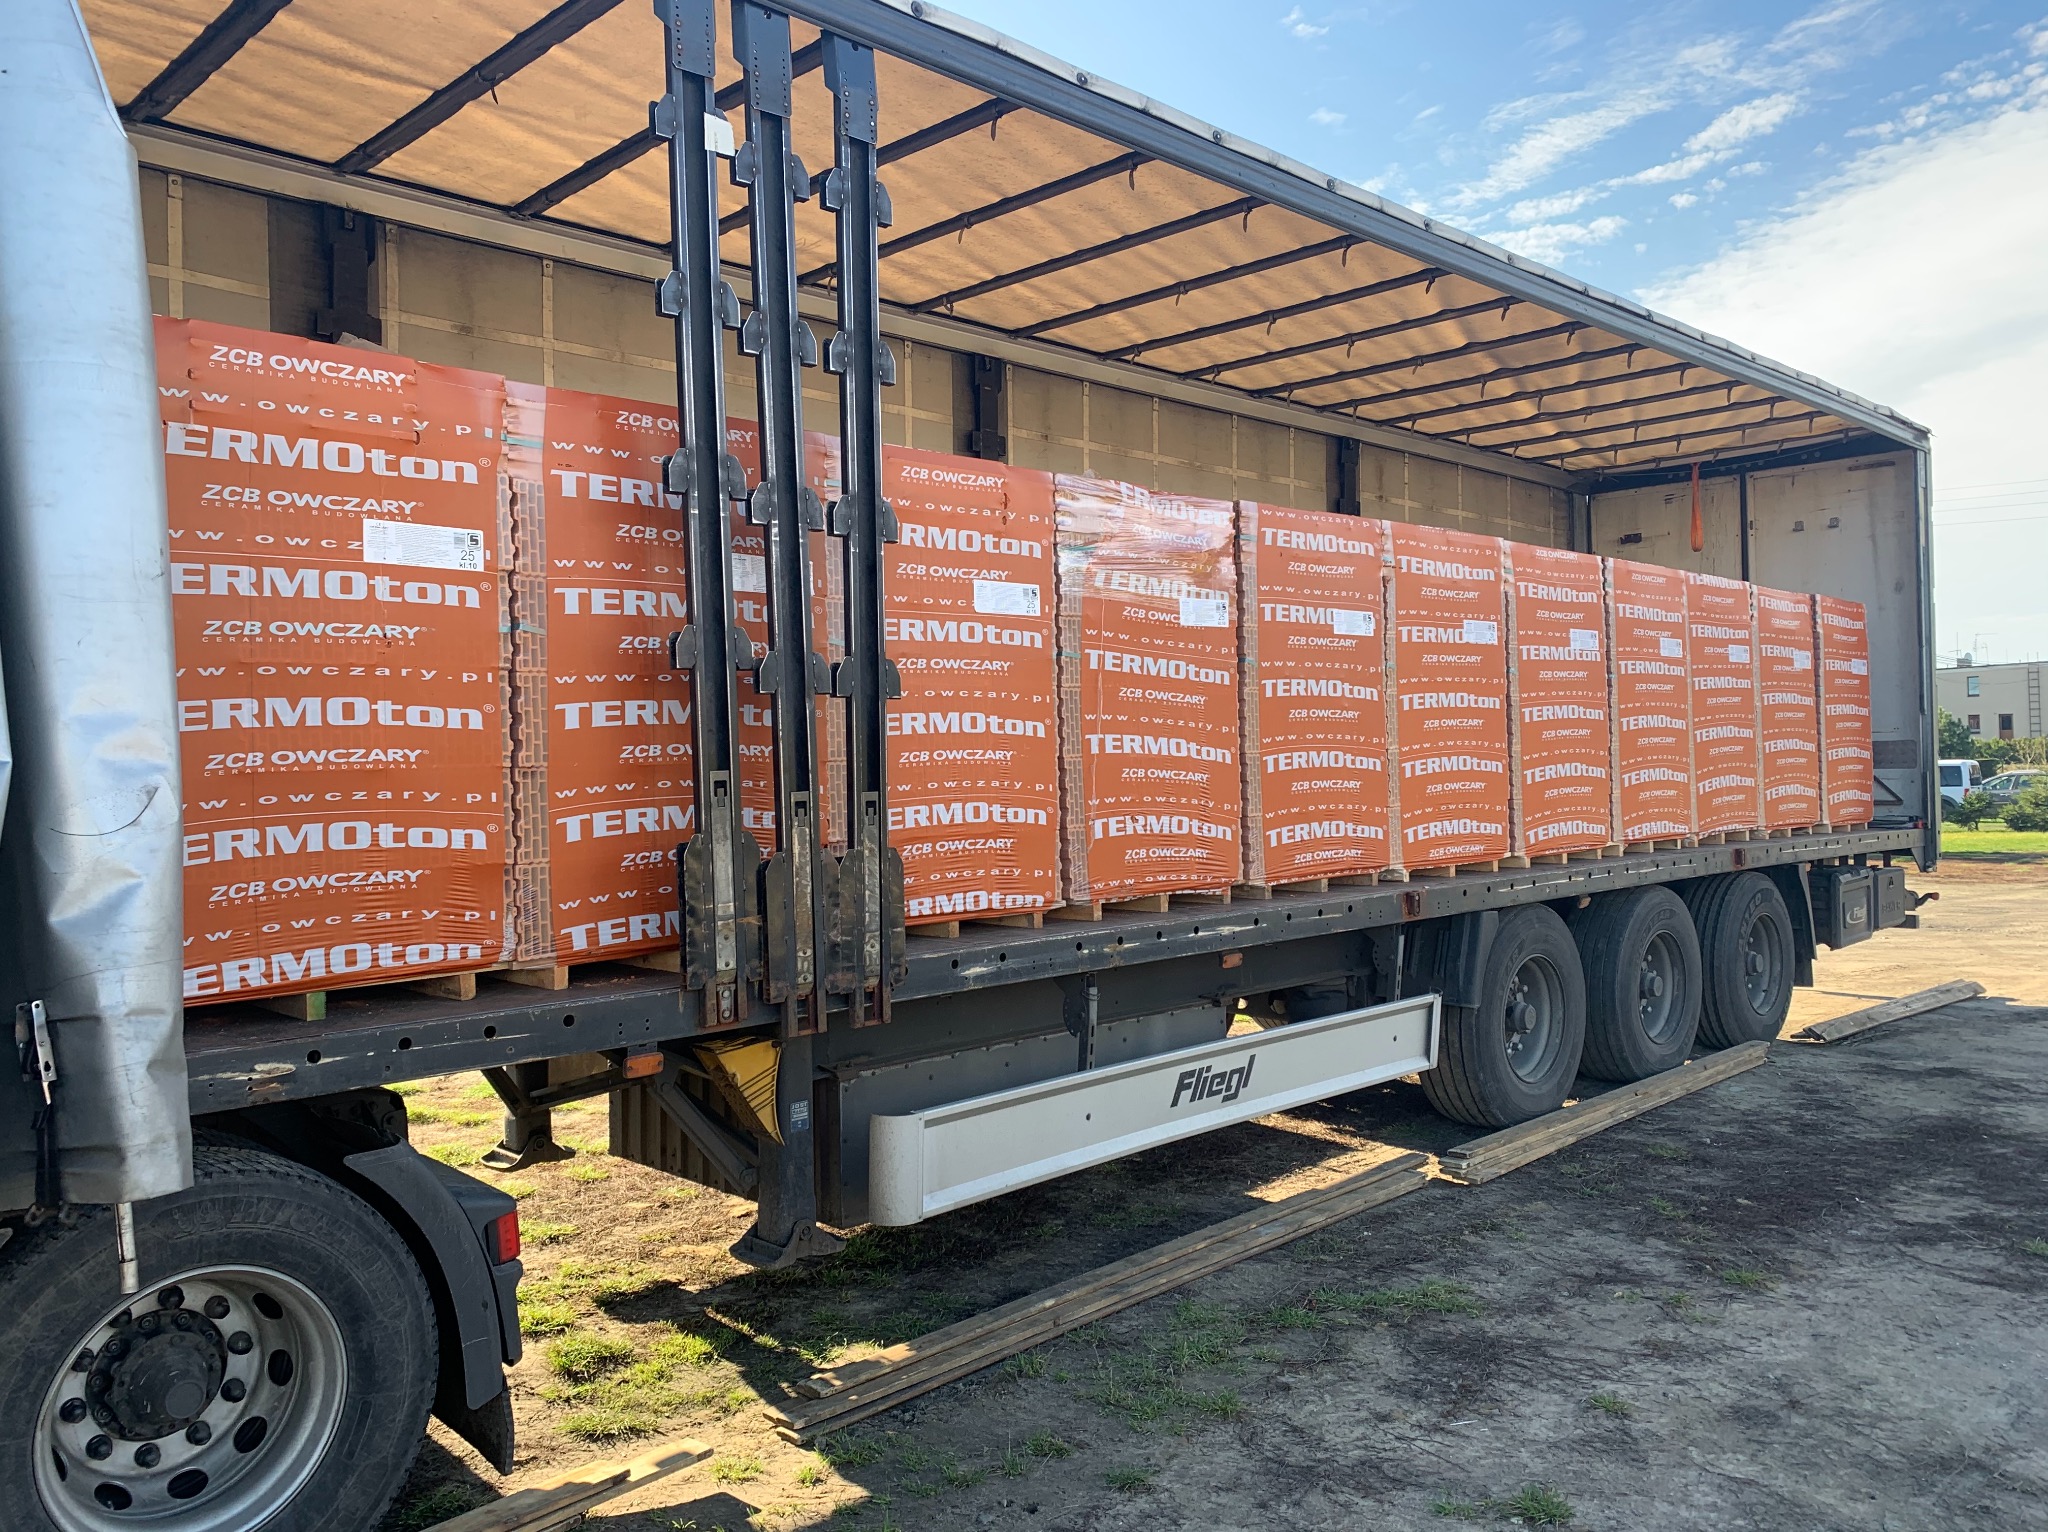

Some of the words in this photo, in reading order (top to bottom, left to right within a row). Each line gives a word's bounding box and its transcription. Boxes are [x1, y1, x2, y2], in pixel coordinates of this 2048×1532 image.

[209, 345, 262, 367] ZCB
[270, 355, 406, 387] OWCZARY
[209, 362, 295, 379] CERAMIKA
[311, 376, 403, 394] BUDOWLANA
[616, 411, 654, 427] ZCB
[616, 425, 676, 438] CERAMIKA
[166, 422, 479, 484] ERMOton
[902, 466, 928, 479] ZCB
[932, 470, 1004, 488] OWCZARY
[202, 484, 260, 502] ZCB
[268, 491, 418, 514] OWCZARY
[201, 500, 295, 514] CERAMIKA
[312, 509, 413, 522] BUDOWLANA
[616, 524, 658, 540] ZCB
[901, 523, 1041, 559] RMOton
[616, 537, 683, 548] CERAMIKA
[1261, 528, 1374, 557] TERMOton
[461, 550, 474, 561] 25
[897, 563, 926, 575] ZCB
[930, 566, 1009, 580] OWCZARY
[1288, 562, 1305, 571] ZCB
[1308, 564, 1355, 574] OWCZARY
[1397, 556, 1495, 581] TERMOton
[172, 562, 480, 609] ERMOton
[1422, 587, 1437, 595] ZCB
[1439, 589, 1478, 598] OWCZARY
[1517, 582, 1597, 603] TERMOton
[1123, 607, 1145, 618] ZCB
[1550, 611, 1584, 619] OWCZARY
[1617, 604, 1682, 623] TERMOton
[203, 620, 262, 635] ZCB
[269, 622, 421, 638] OWCZARY
[885, 619, 1042, 648] ERMOton
[1691, 624, 1749, 639] TERMOton
[202, 636, 296, 644] CERAMIKA
[619, 636, 661, 648] ZCB
[1288, 636, 1305, 645] ZCB
[1308, 637, 1357, 647] OWCZARY
[897, 659, 927, 668] ZCB
[932, 658, 1011, 671] OWCZARY
[1085, 649, 1230, 685] TERMOton
[1440, 655, 1481, 663] OWCZARY
[1619, 661, 1685, 676] TERMOton
[1261, 679, 1378, 701] TERMOton
[1693, 677, 1751, 690] TERMOton
[1119, 688, 1142, 698] ZCB
[1145, 690, 1205, 705] OWCZARY
[1400, 693, 1500, 710] TERMOton
[178, 697, 483, 731] ERMOton
[1289, 710, 1307, 718] ZCB
[1310, 709, 1359, 719] OWCZARY
[1522, 705, 1604, 722] TERMOton
[887, 712, 1045, 738] ERMOton
[1424, 720, 1439, 728] ZCB
[1621, 715, 1686, 731] TERMOton
[1695, 726, 1753, 742] TERMOton
[619, 744, 662, 758] ZCB
[900, 752, 929, 763] ZCB
[934, 750, 1013, 760] OWCZARY
[1085, 734, 1231, 764] TERMOton
[205, 753, 263, 769] ZCB
[271, 749, 421, 764] OWCZARY
[619, 756, 688, 764] CERAMIKA
[1263, 751, 1382, 773] TERMOton
[1402, 756, 1503, 778] TERMOton
[204, 766, 299, 777] CERAMIKA
[1122, 768, 1144, 778] ZCB
[1147, 769, 1208, 782] OWCZARY
[1524, 763, 1606, 784] TERMOton
[1622, 768, 1688, 787] TERMOton
[1291, 782, 1309, 790] ZCB
[1311, 780, 1360, 788] OWCZARY
[1444, 782, 1485, 790] OWCZARY
[1698, 775, 1755, 795] TERMOton
[888, 802, 1046, 830] ERMOton
[1089, 816, 1232, 840] TERMOton
[1266, 821, 1383, 847] TERMOton
[1404, 818, 1502, 843] TERMOton
[1526, 821, 1606, 844] TERMOton
[183, 821, 488, 867] ERMOton
[903, 843, 932, 856] ZCB
[936, 839, 1013, 851] OWCZARY
[621, 851, 662, 866] ZCB
[209, 883, 264, 901] ZCB
[272, 870, 423, 892] OWCZARY
[209, 892, 299, 909] CERAMIKA
[318, 884, 417, 895] BUDOWLANA
[910, 891, 1044, 917] RMOton
[184, 942, 490, 997] ERMOton
[1170, 1054, 1256, 1108] Fliegl
